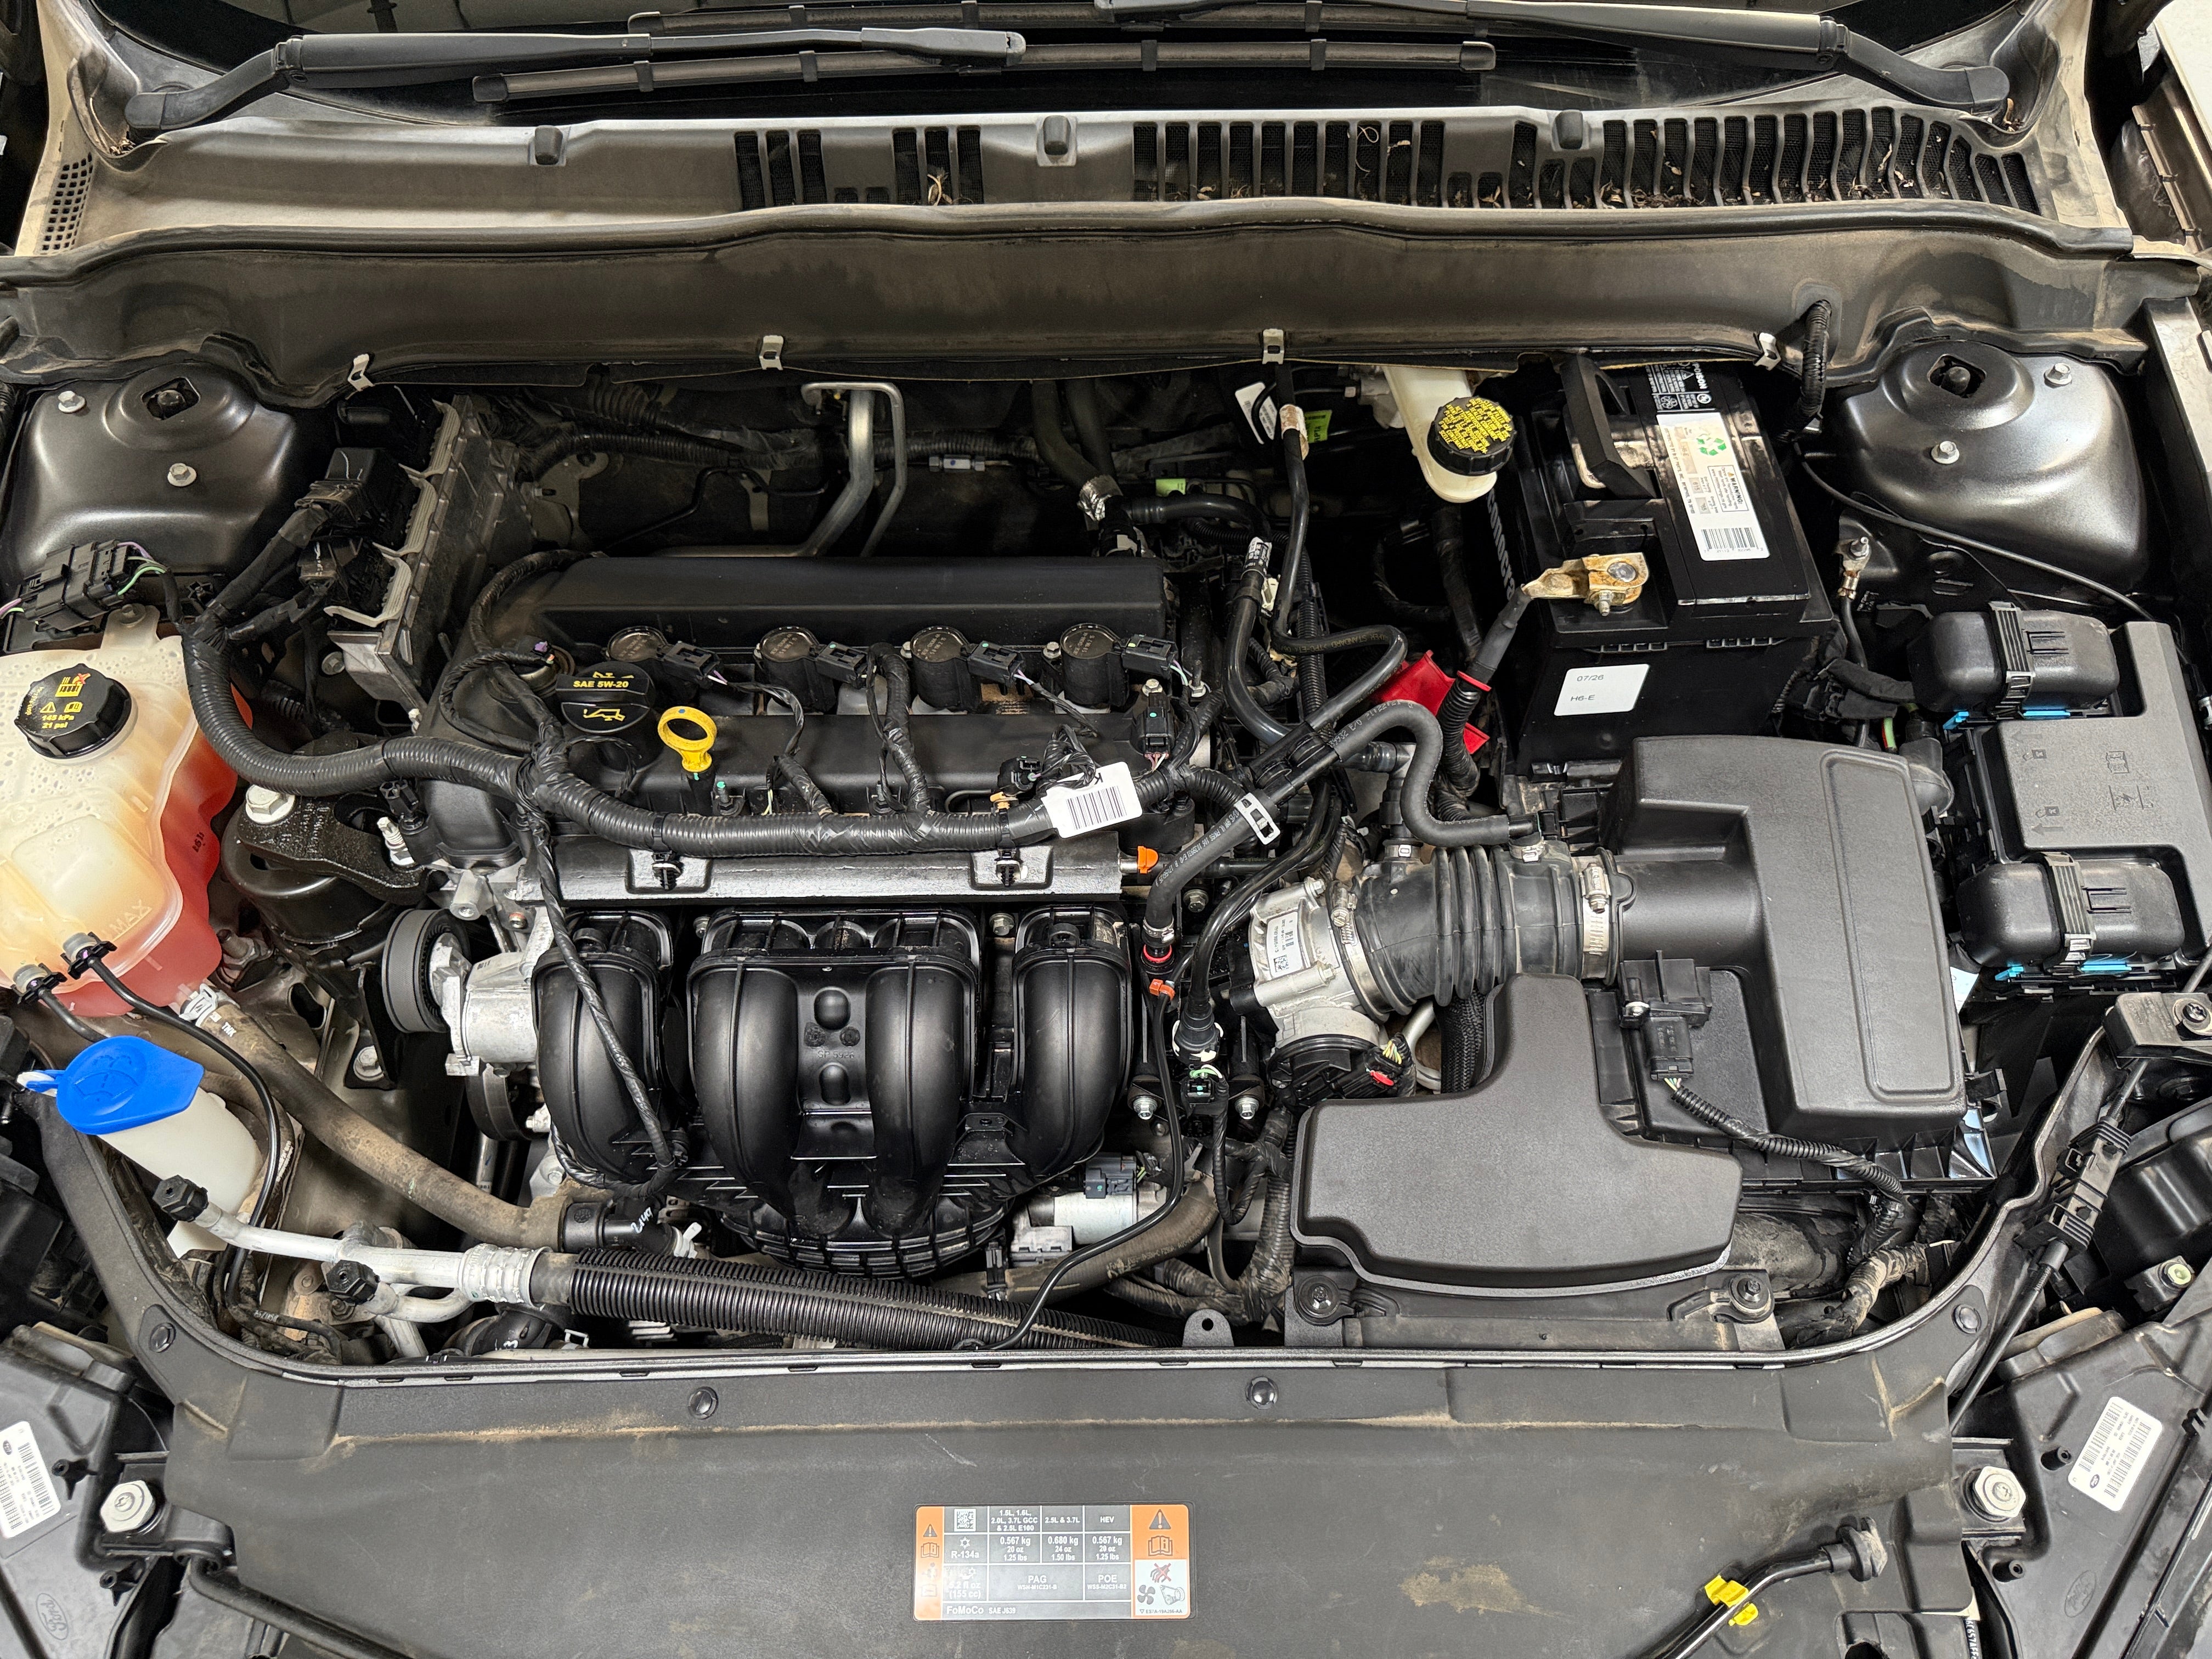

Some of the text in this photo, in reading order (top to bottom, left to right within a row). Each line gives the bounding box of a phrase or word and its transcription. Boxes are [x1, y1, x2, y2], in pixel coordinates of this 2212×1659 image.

[1692, 362, 1708, 389] POISON
[54, 721, 69, 730] psi
[109, 899, 151, 935] MAX
[221, 1021, 237, 1039] TNK
[1000, 1536, 1031, 1546] 0.567 kg
[1047, 1536, 1079, 1546] 0.680 kg
[1092, 1536, 1123, 1546] 0.567 kg
[951, 1550, 980, 1559] R-134a
[1028, 1575, 1047, 1584] PAG
[1098, 1575, 1118, 1583] POE
[949, 1589, 981, 1599] (155 cc)
[946, 1606, 984, 1615] FoMoCo
